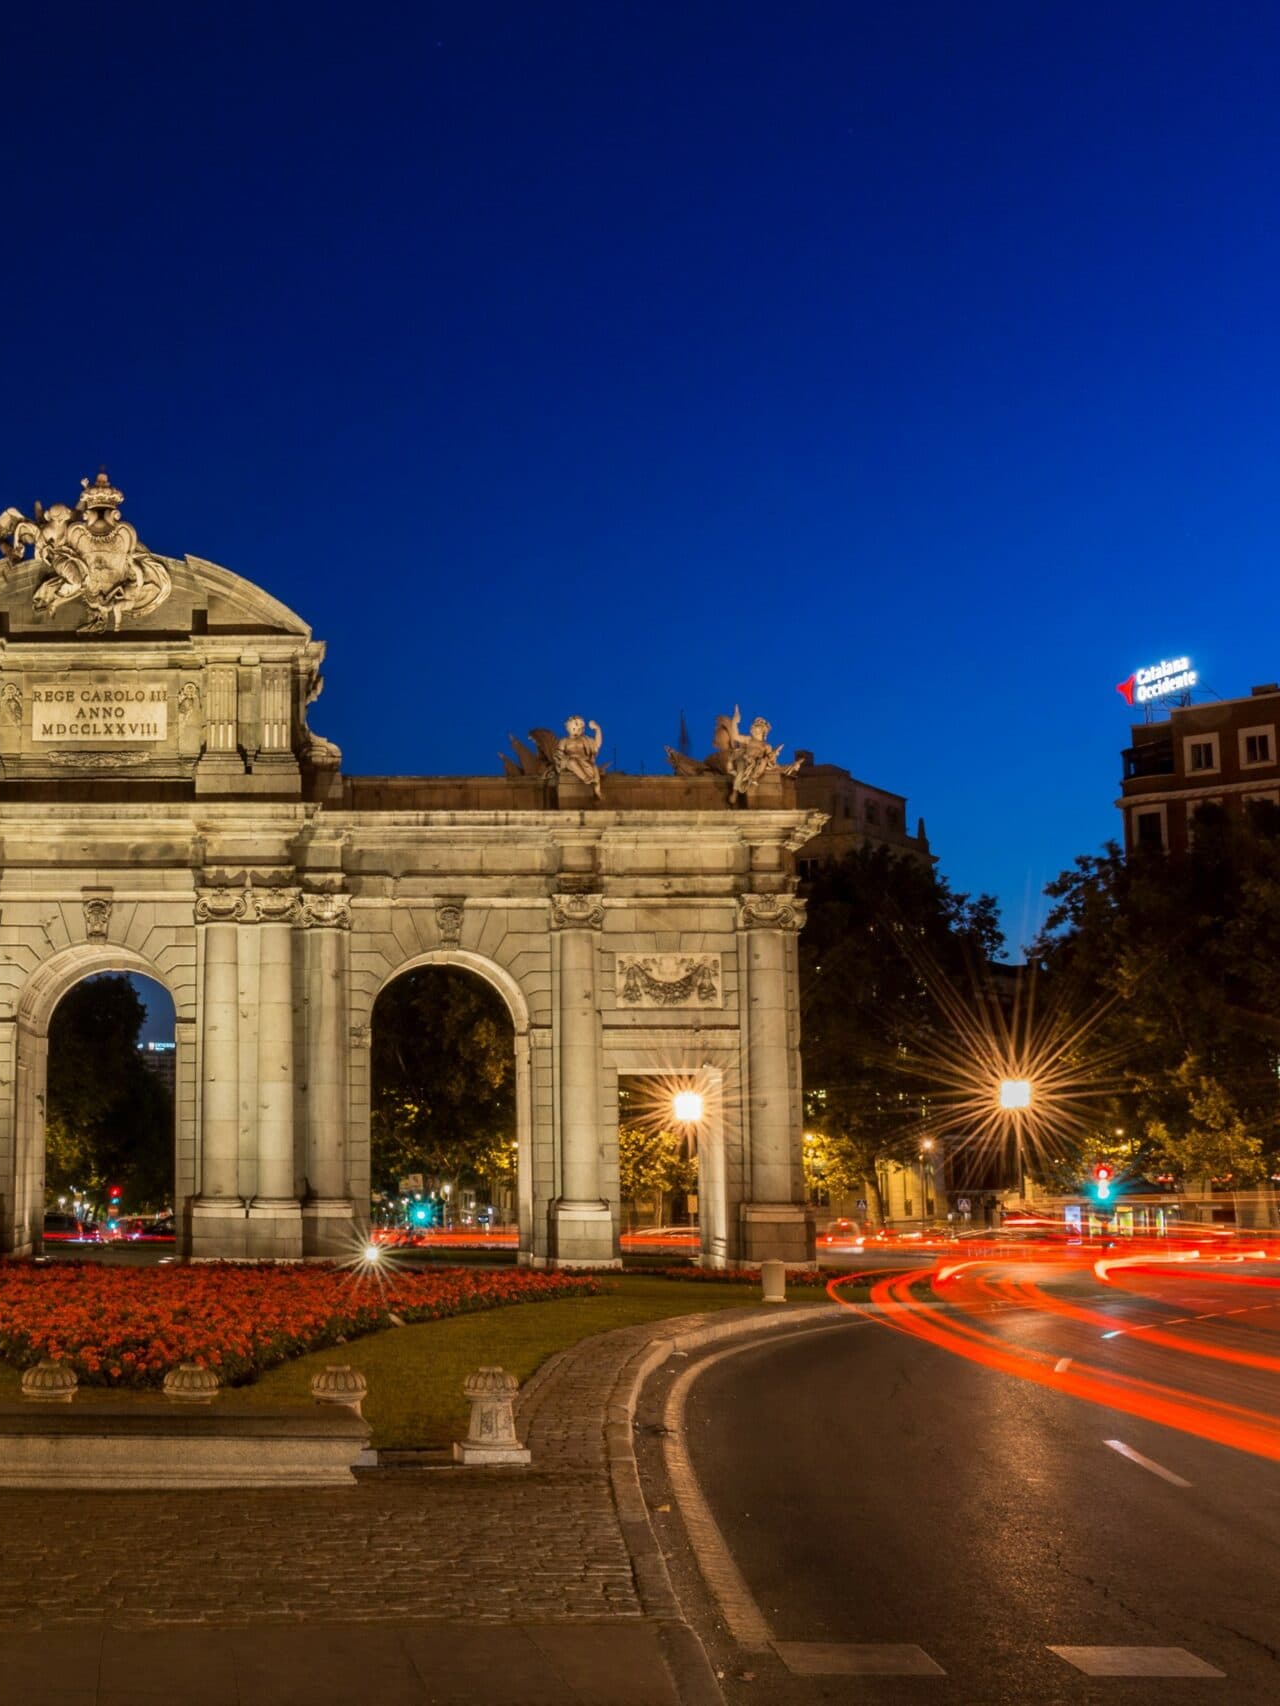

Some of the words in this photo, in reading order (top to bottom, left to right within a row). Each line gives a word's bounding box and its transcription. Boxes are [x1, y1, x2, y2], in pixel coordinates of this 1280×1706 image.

[33, 690, 75, 702] REGE
[81, 690, 146, 702] CAROLO
[150, 690, 168, 702] III
[76, 707, 125, 719] ANNO
[41, 723, 158, 736] MDCCLXXVIII
